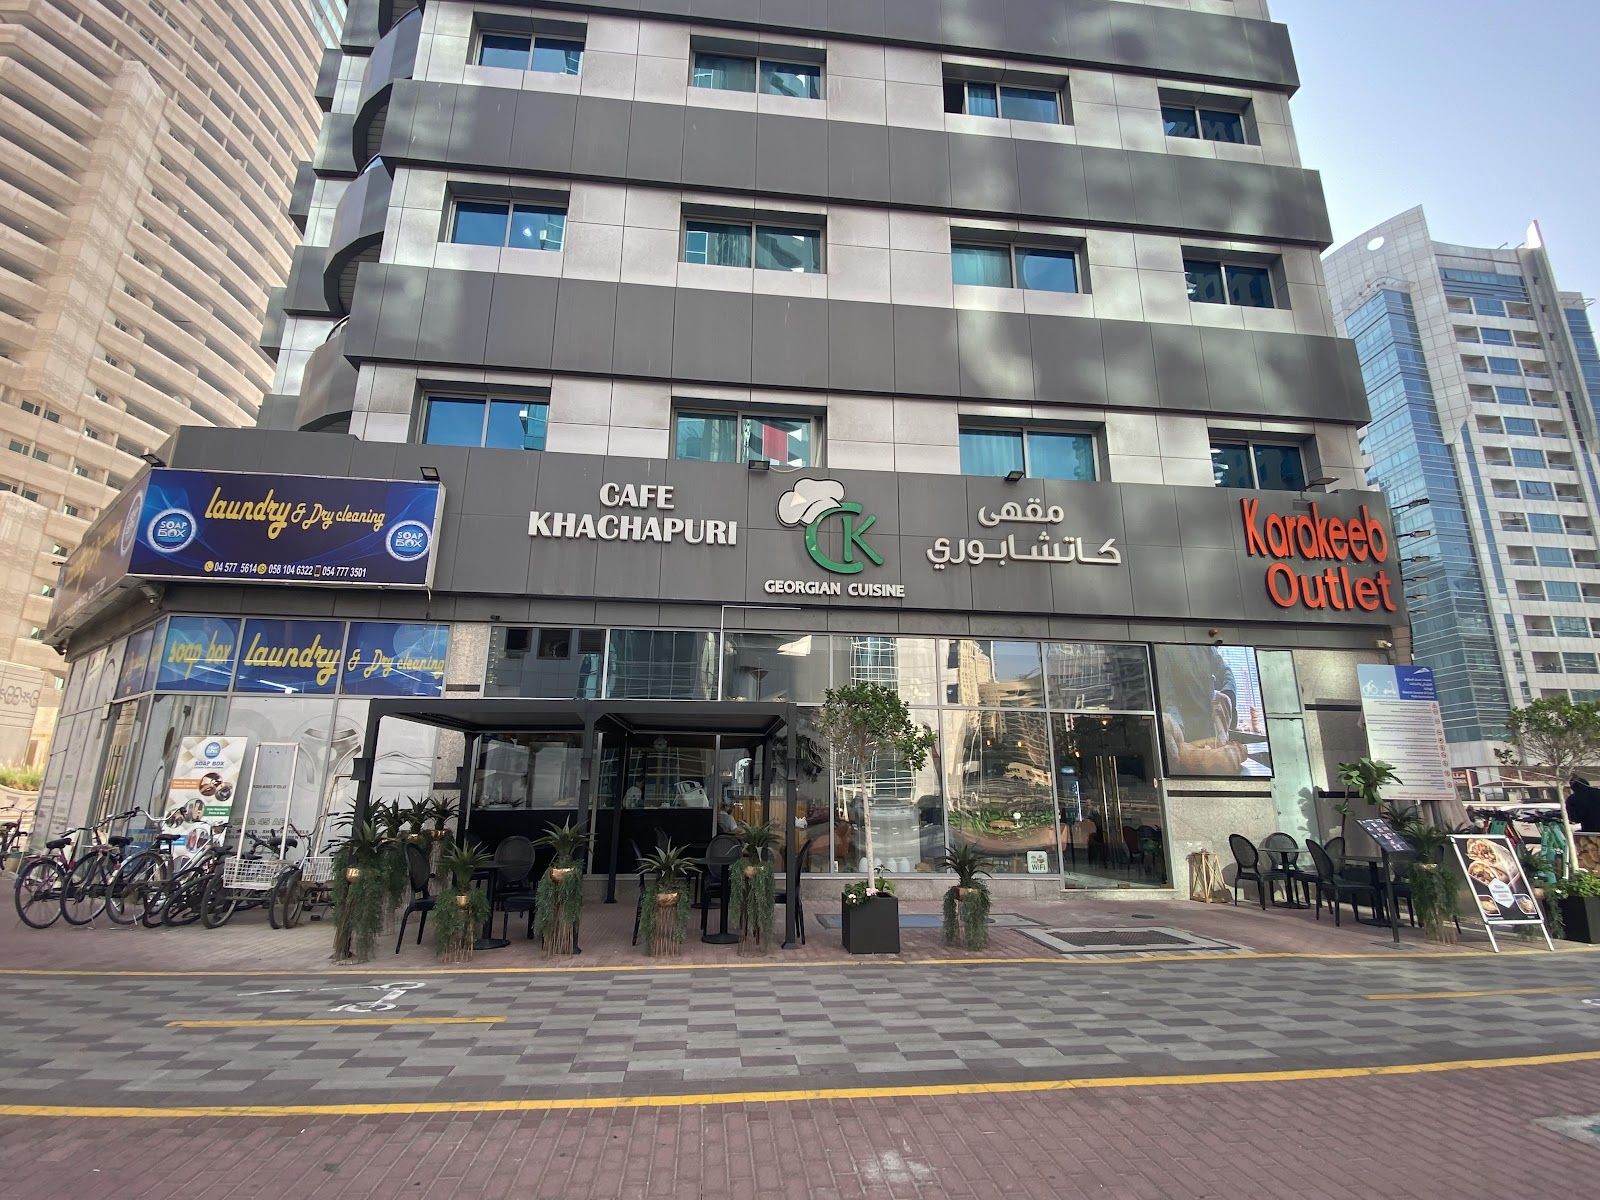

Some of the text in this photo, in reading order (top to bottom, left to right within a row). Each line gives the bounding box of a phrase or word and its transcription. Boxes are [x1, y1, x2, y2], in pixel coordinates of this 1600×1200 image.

[599, 482, 675, 510] CAFE
[160, 520, 188, 530] SOAP
[204, 486, 386, 540] laundry & Dry cleaning
[977, 498, 1065, 527] مقهى
[157, 528, 186, 538] BOX
[397, 531, 424, 540] SOAP
[527, 511, 738, 546] KHACHAPURI
[1239, 497, 1389, 563] Karakeeb
[395, 539, 423, 548] BOX
[926, 530, 1122, 571] كاتشابوري
[214, 562, 367, 578] 04 577 5614 058 104 6322 054 777 3501
[764, 579, 906, 598] GEORGIAN CUISINE
[1264, 562, 1398, 613] Outlet
[170, 640, 202, 679] soap
[205, 630, 231, 664] box
[243, 632, 342, 686] laundry
[347, 648, 361, 671] &
[363, 648, 394, 679] Dry
[397, 651, 445, 679] cleaning
